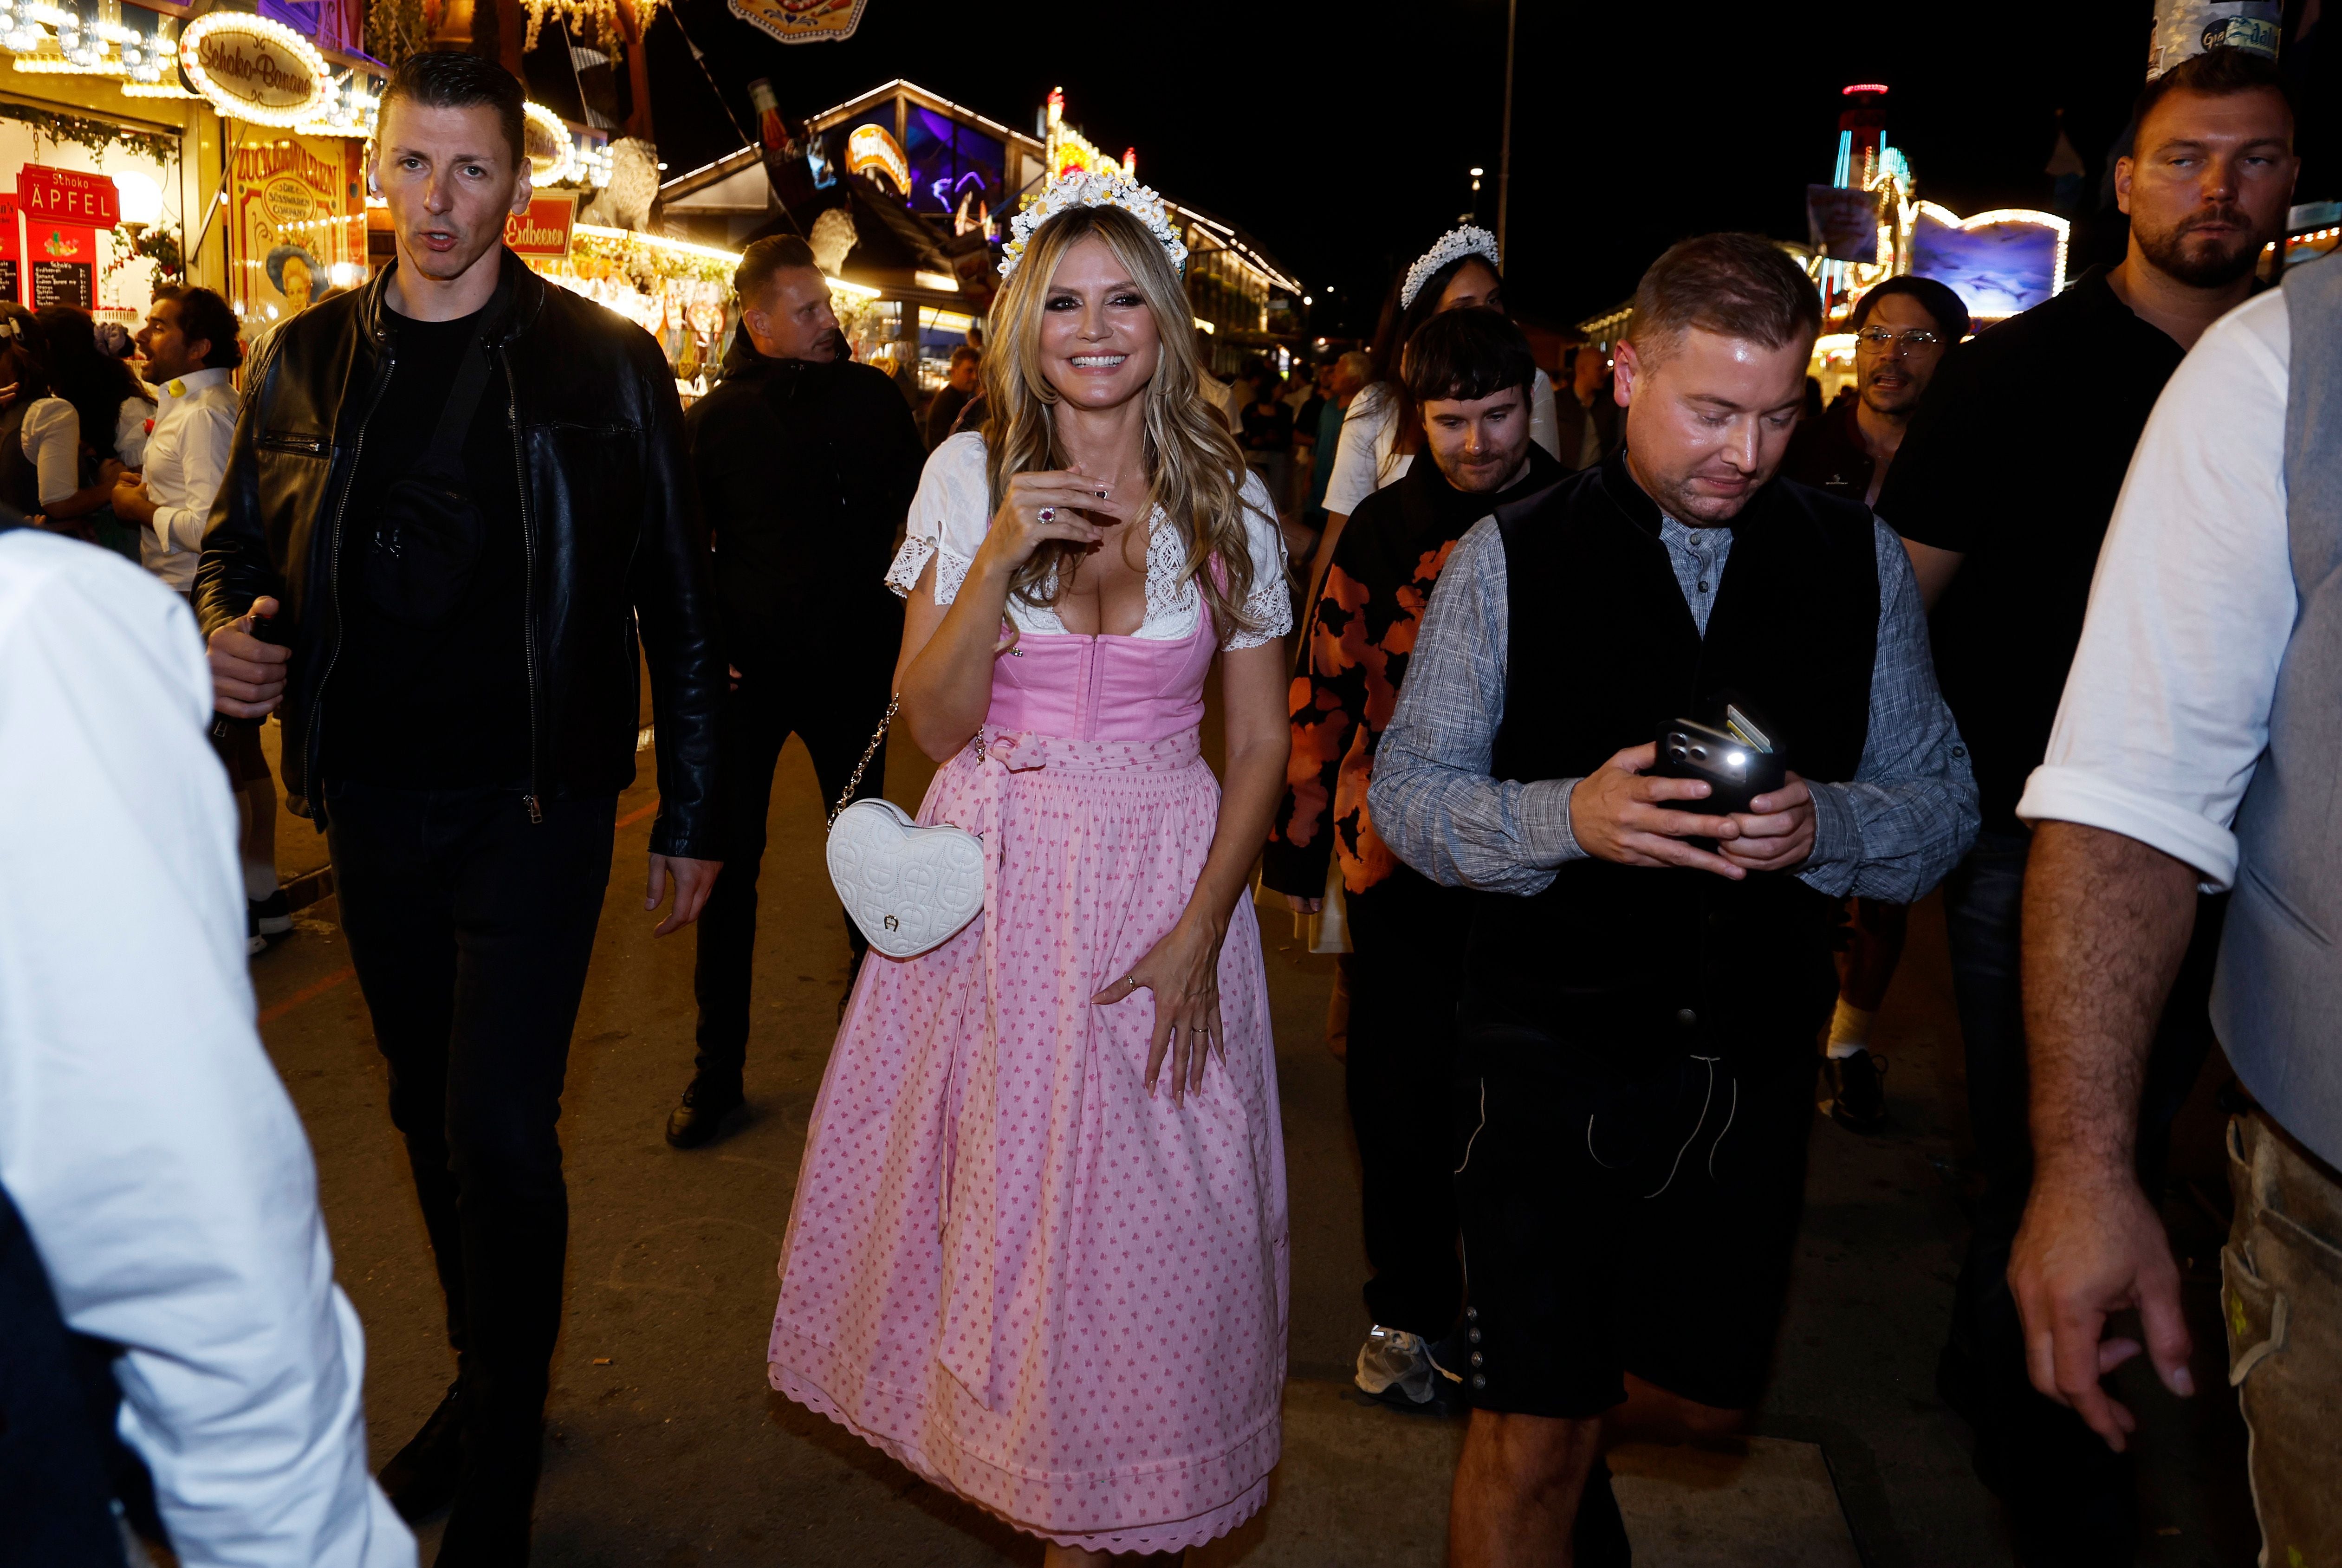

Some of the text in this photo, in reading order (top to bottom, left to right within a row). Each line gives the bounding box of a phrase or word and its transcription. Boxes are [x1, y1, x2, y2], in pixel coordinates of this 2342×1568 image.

[200, 35, 311, 96] Schoko-Banane
[52, 172, 89, 189] Schoko
[237, 138, 337, 197] ZUCKERWAREN
[32, 183, 110, 217] ÄPFEL
[272, 204, 306, 217] COMPANY
